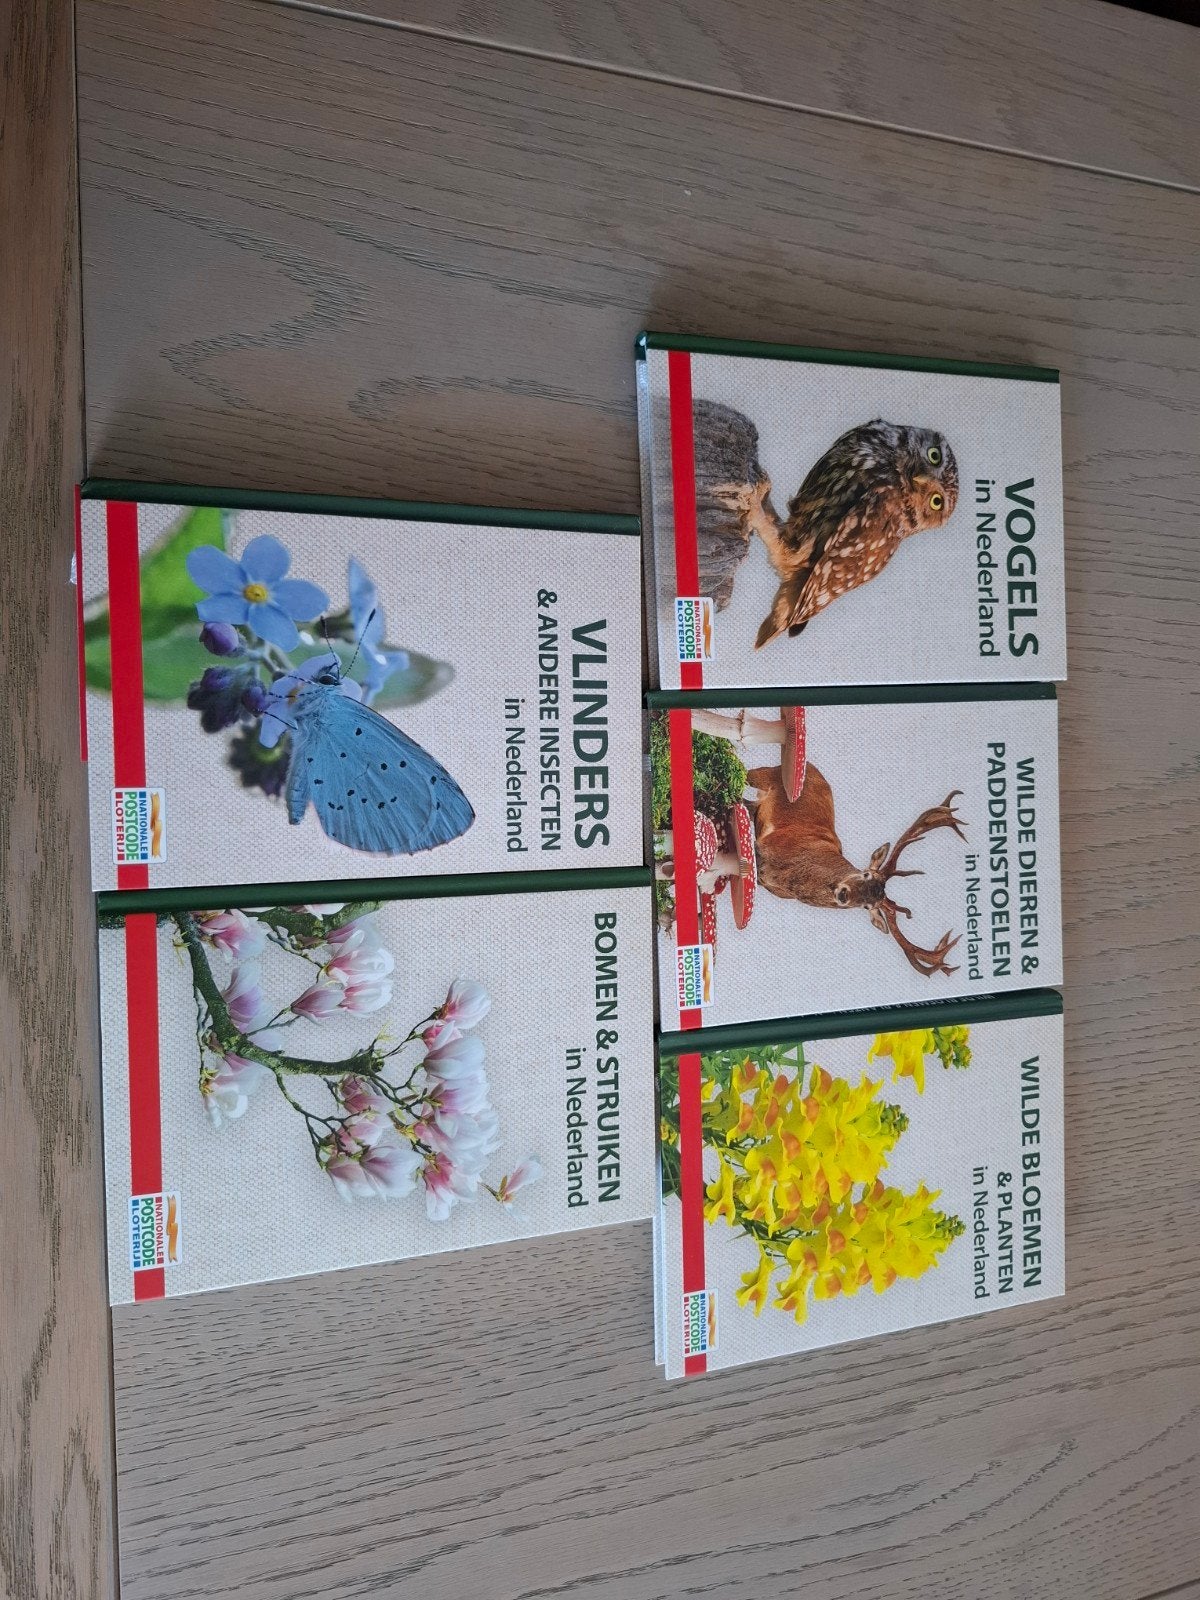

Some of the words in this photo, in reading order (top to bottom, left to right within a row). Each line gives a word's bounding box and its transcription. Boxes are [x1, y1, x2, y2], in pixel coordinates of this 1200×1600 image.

[976, 479, 995, 503] in
[976, 513, 1000, 656] Nederland
[1005, 478, 1038, 657] VOGELS
[537, 589, 557, 608] &
[677, 607, 685, 653] LOTERIJ
[684, 600, 695, 659] POSTCODE
[693, 606, 702, 652] NATIONALE
[538, 614, 559, 720] ANDERE
[505, 699, 525, 719] in
[572, 619, 610, 848] VLINDERS
[506, 728, 528, 852] Nederland
[540, 728, 561, 850] INSECTEN
[1017, 757, 1035, 843] WILDE
[115, 799, 125, 853] LOTERIJ
[124, 791, 139, 861] POSTCODE
[139, 799, 148, 853] NATIONALE
[965, 854, 981, 872] in
[987, 743, 1010, 976] PADDENSTOELEN
[966, 878, 983, 980] Nederland
[1019, 851, 1038, 948] DIEREN
[595, 913, 618, 1021] BOMEN
[677, 956, 685, 1001] LOTERIJ
[684, 948, 695, 1007] POSTCODE
[694, 953, 702, 999] NATIONALE
[1021, 955, 1039, 974] &
[566, 1048, 585, 1071] in
[596, 1029, 618, 1051] &
[597, 1057, 620, 1202] STRUIKEN
[1021, 1056, 1040, 1146] WILDE
[567, 1077, 589, 1207] Nederland
[973, 1167, 989, 1186] in
[997, 1172, 1012, 1187] &
[132, 1206, 141, 1260] LOTERIJ
[141, 1197, 155, 1266] POSTCODE
[155, 1203, 164, 1257] NATIONALE
[974, 1191, 990, 1299] Nederland
[998, 1192, 1013, 1294] PLANTEN
[1021, 1151, 1042, 1287] BLOEMEN
[690, 1294, 700, 1353] POSTCODE
